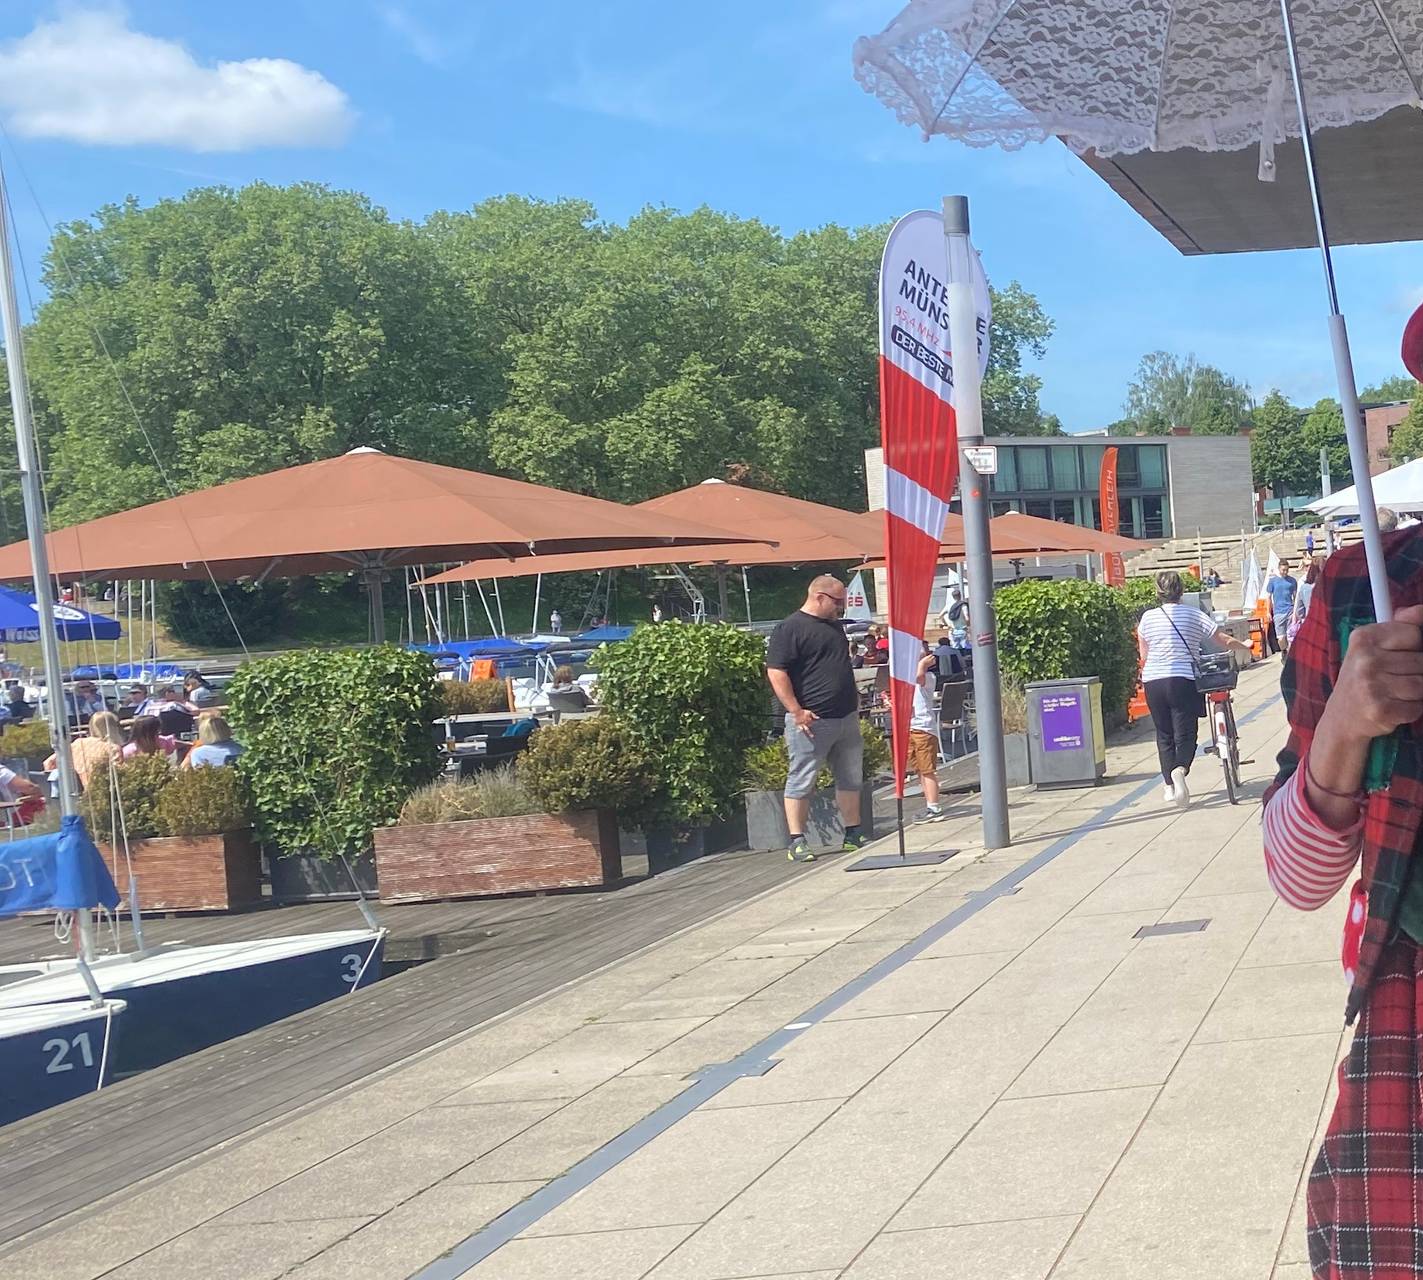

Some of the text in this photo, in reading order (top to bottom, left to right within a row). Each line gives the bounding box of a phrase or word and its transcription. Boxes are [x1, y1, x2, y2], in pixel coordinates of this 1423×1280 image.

[896, 329, 916, 353] DER
[916, 345, 945, 376] BESTE
[341, 954, 362, 983] 3
[42, 1032, 93, 1073] 21
